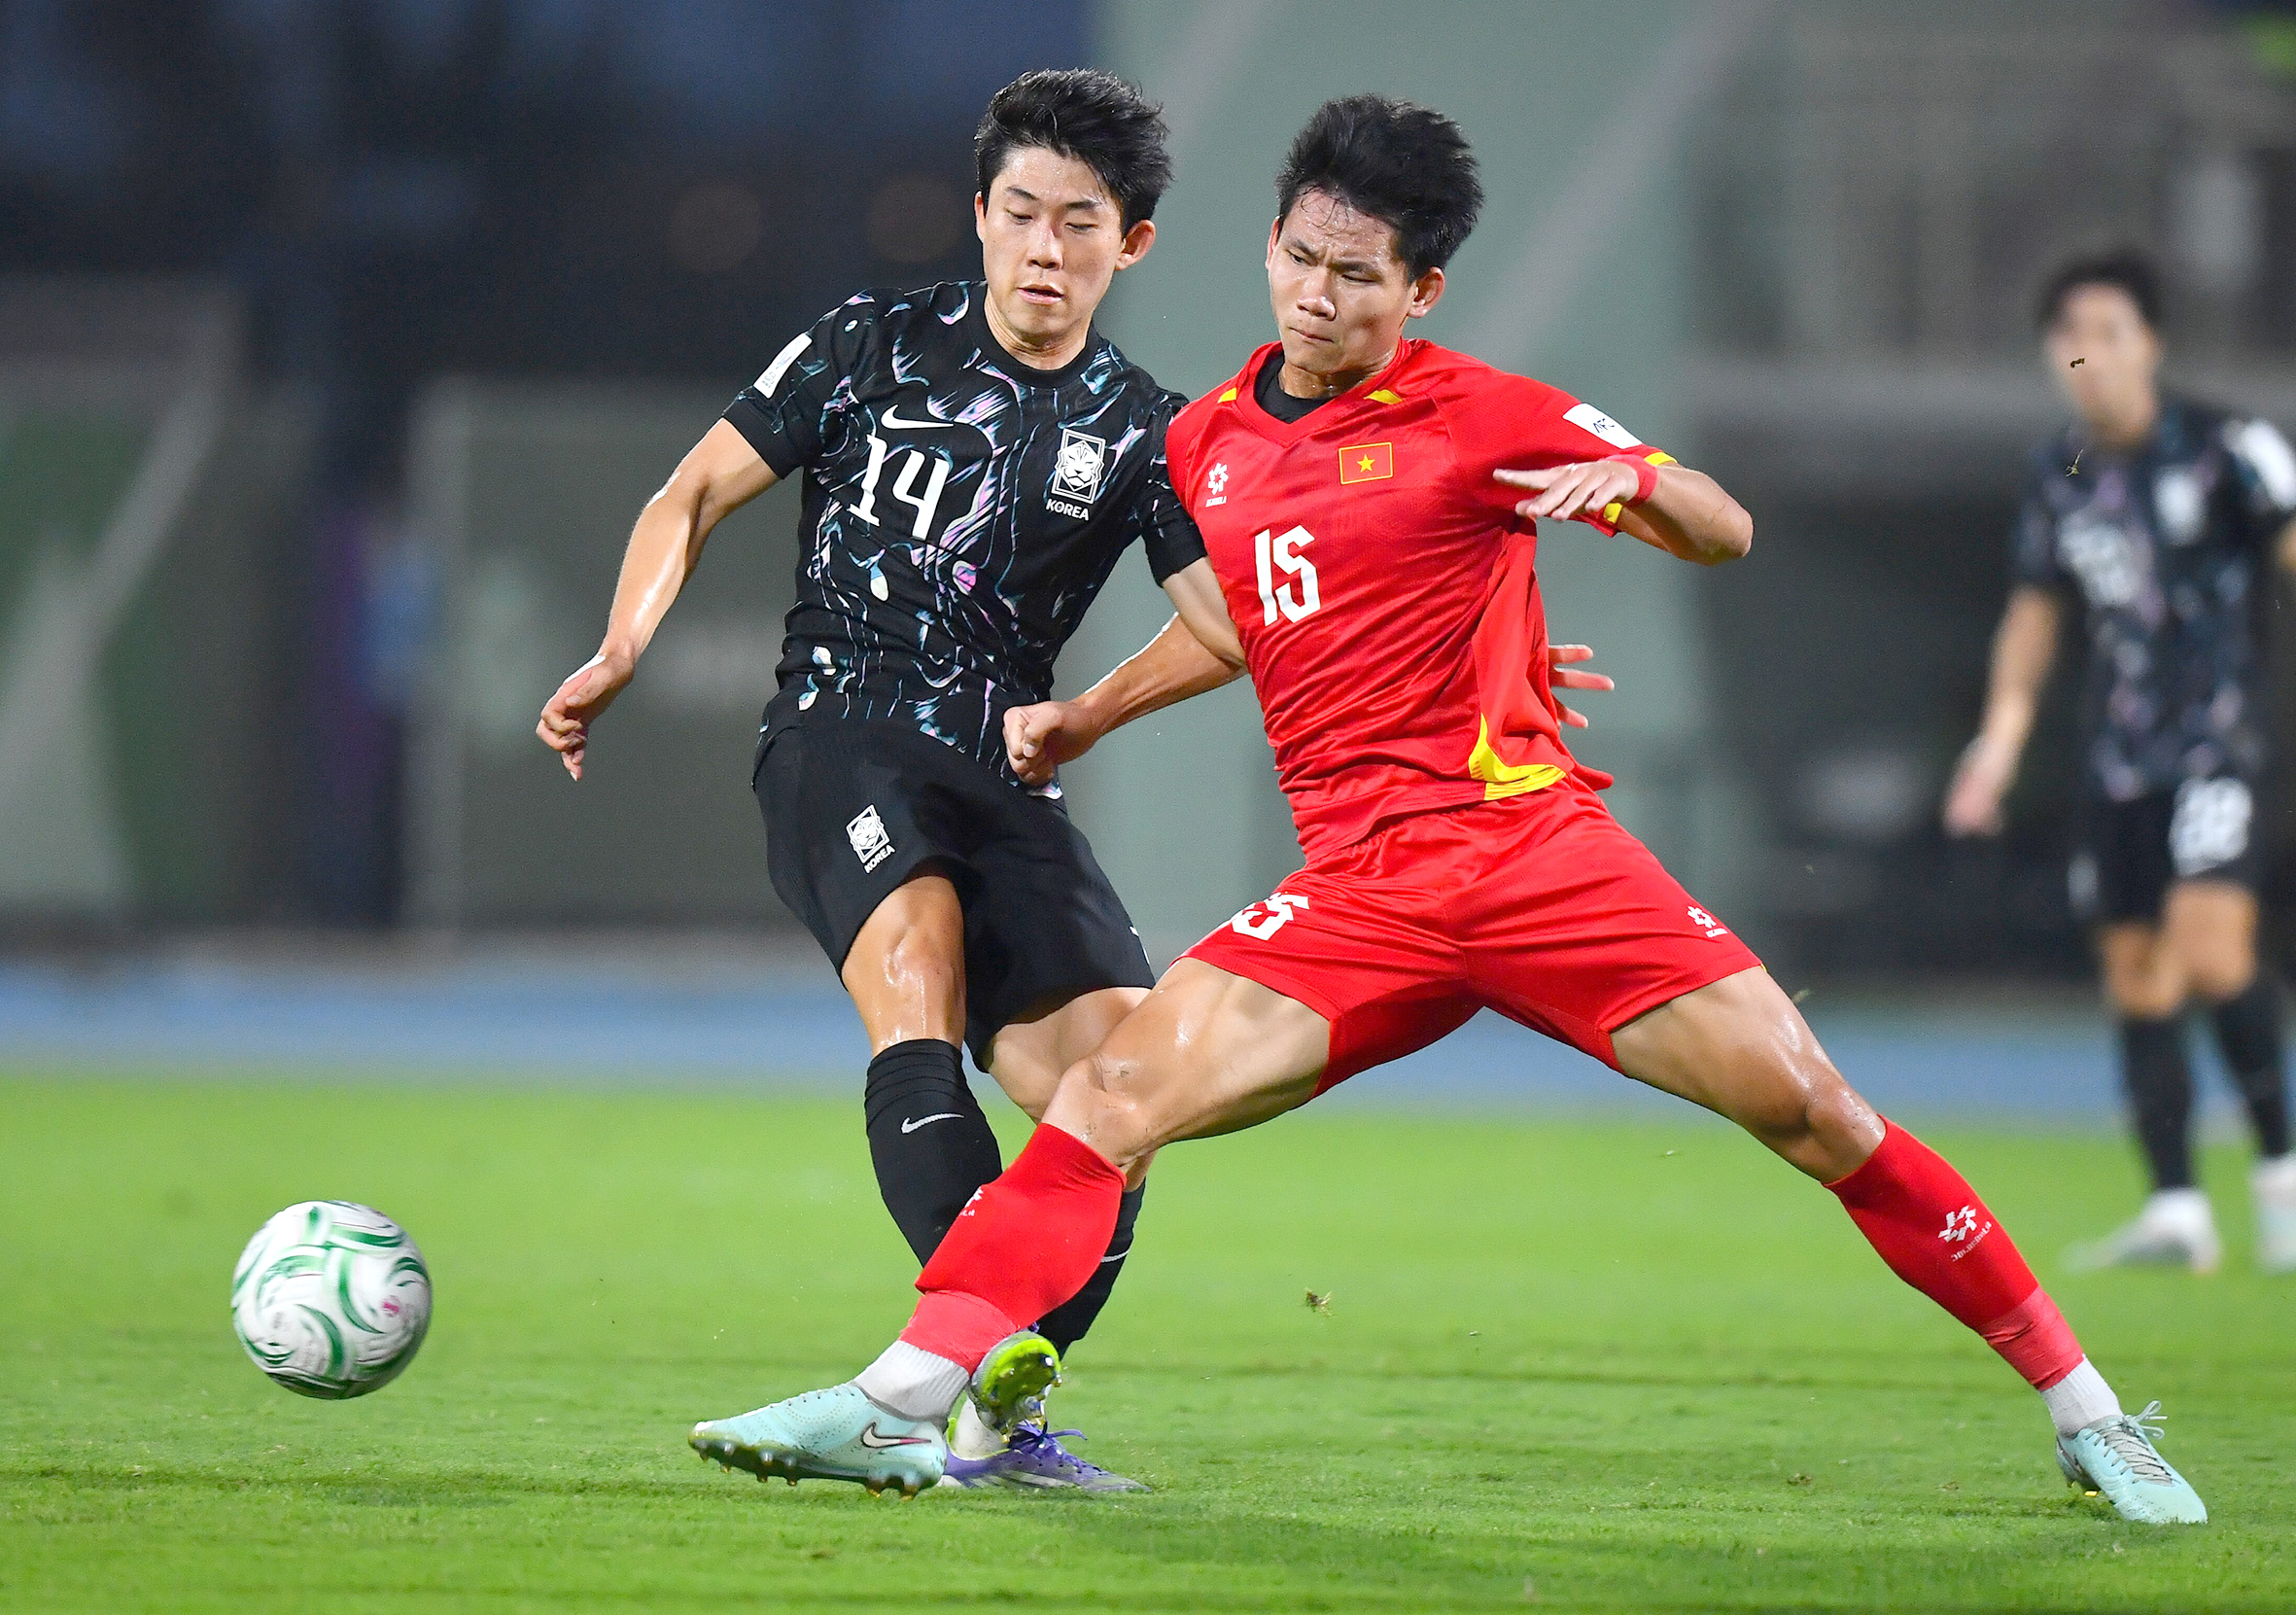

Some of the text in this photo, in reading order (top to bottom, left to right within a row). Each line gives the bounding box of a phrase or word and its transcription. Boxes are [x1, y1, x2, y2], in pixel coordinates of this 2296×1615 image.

[848, 434, 951, 541] 14
[1046, 498, 1090, 521] KOREA
[1254, 524, 1321, 627] 15
[863, 844, 896, 874] KOREA
